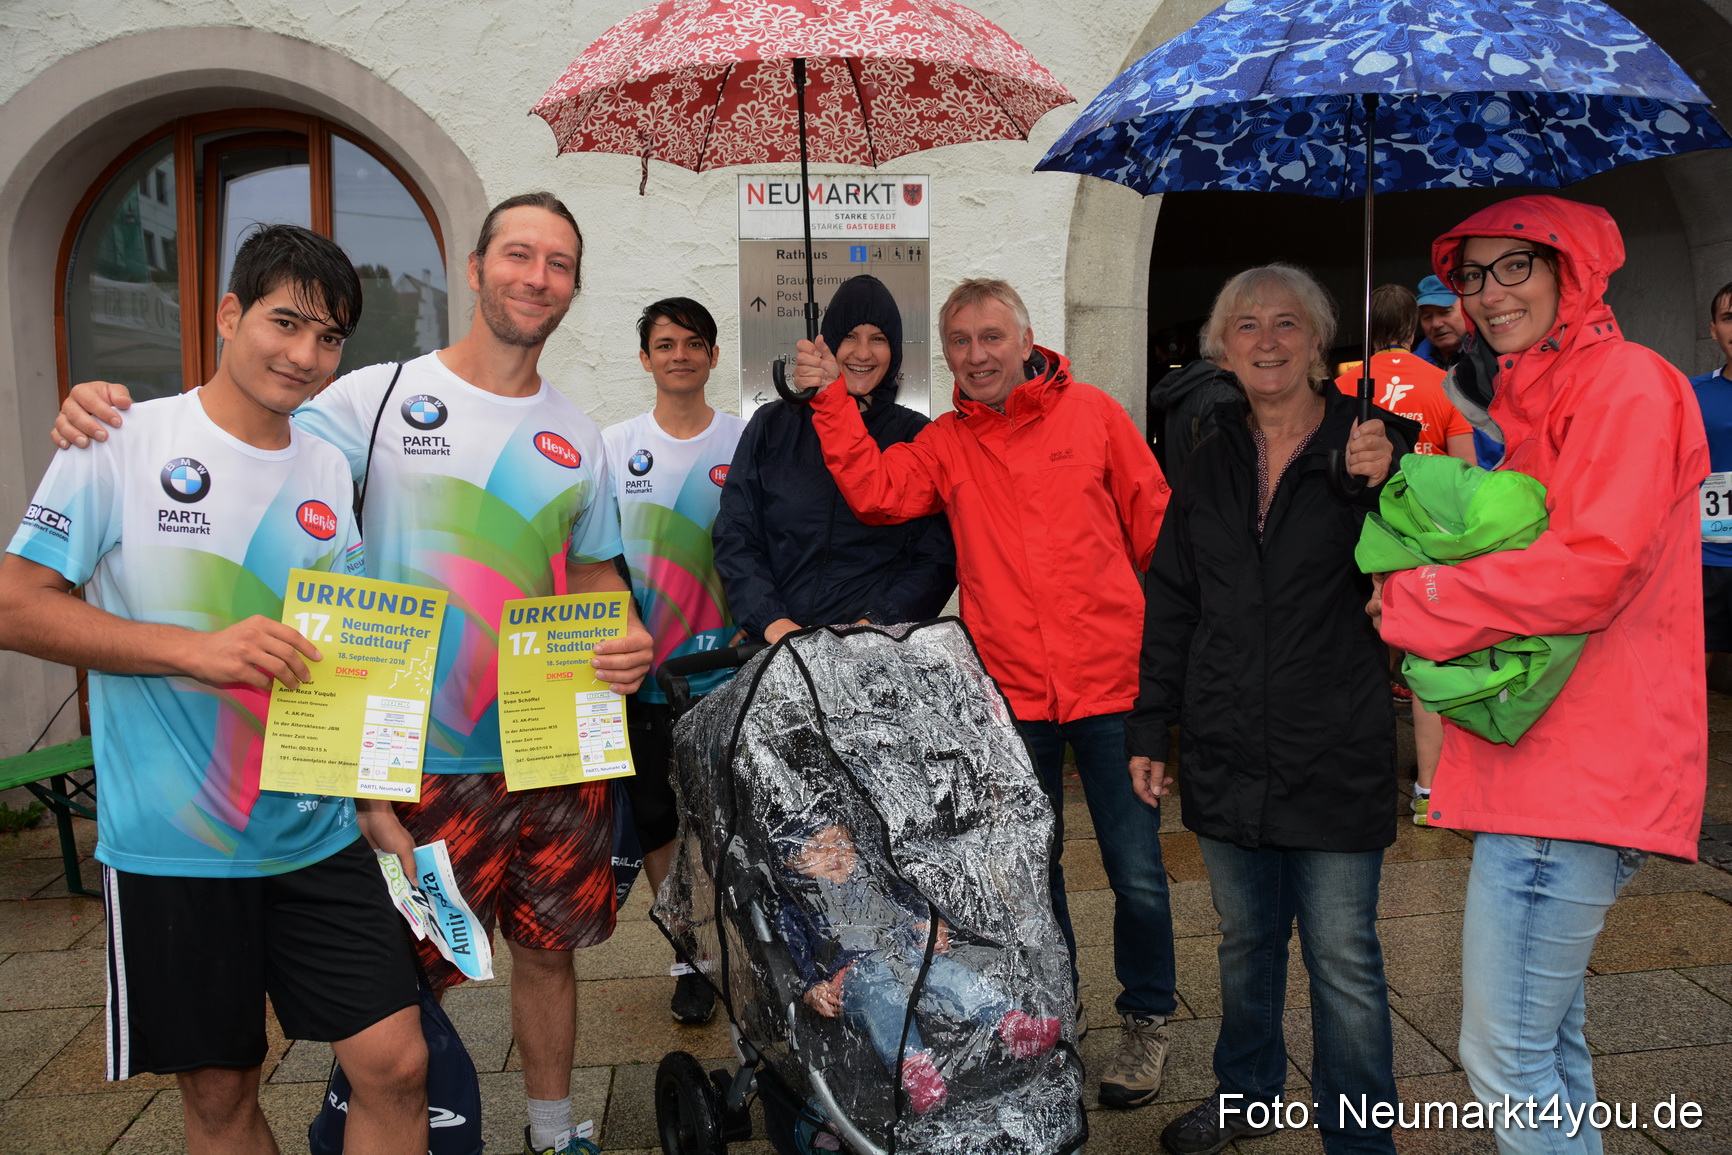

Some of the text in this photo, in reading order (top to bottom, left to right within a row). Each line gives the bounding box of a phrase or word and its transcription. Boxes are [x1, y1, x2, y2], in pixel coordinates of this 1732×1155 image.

[747, 183, 896, 205] NEUMARKT
[776, 249, 828, 260] Rathus
[776, 291, 803, 301] Post
[777, 306, 828, 317] Bahnof
[405, 395, 444, 408] BMW
[402, 436, 450, 448] PARTL
[404, 447, 450, 456] Neumarkt
[541, 436, 577, 463] Hervis
[165, 458, 207, 476] BMW
[625, 480, 652, 488] PARTL
[158, 510, 211, 525] PARTL
[303, 506, 335, 531] Hervis
[158, 523, 211, 535] Neumarkt
[296, 581, 437, 619] URKUNDE
[508, 601, 622, 626] URKUNDE
[294, 612, 431, 643] 17. Neumarkter
[340, 632, 412, 653] Stadtlauf
[508, 627, 620, 656] 17. Neumarkter
[546, 639, 603, 653] Stadtla
[338, 652, 406, 665] 18. September 2016
[555, 659, 589, 667] September
[335, 667, 361, 676] DKMS
[546, 672, 568, 680] DKMS
[360, 783, 378, 791] PARTL
[446, 912, 471, 955] Amir
